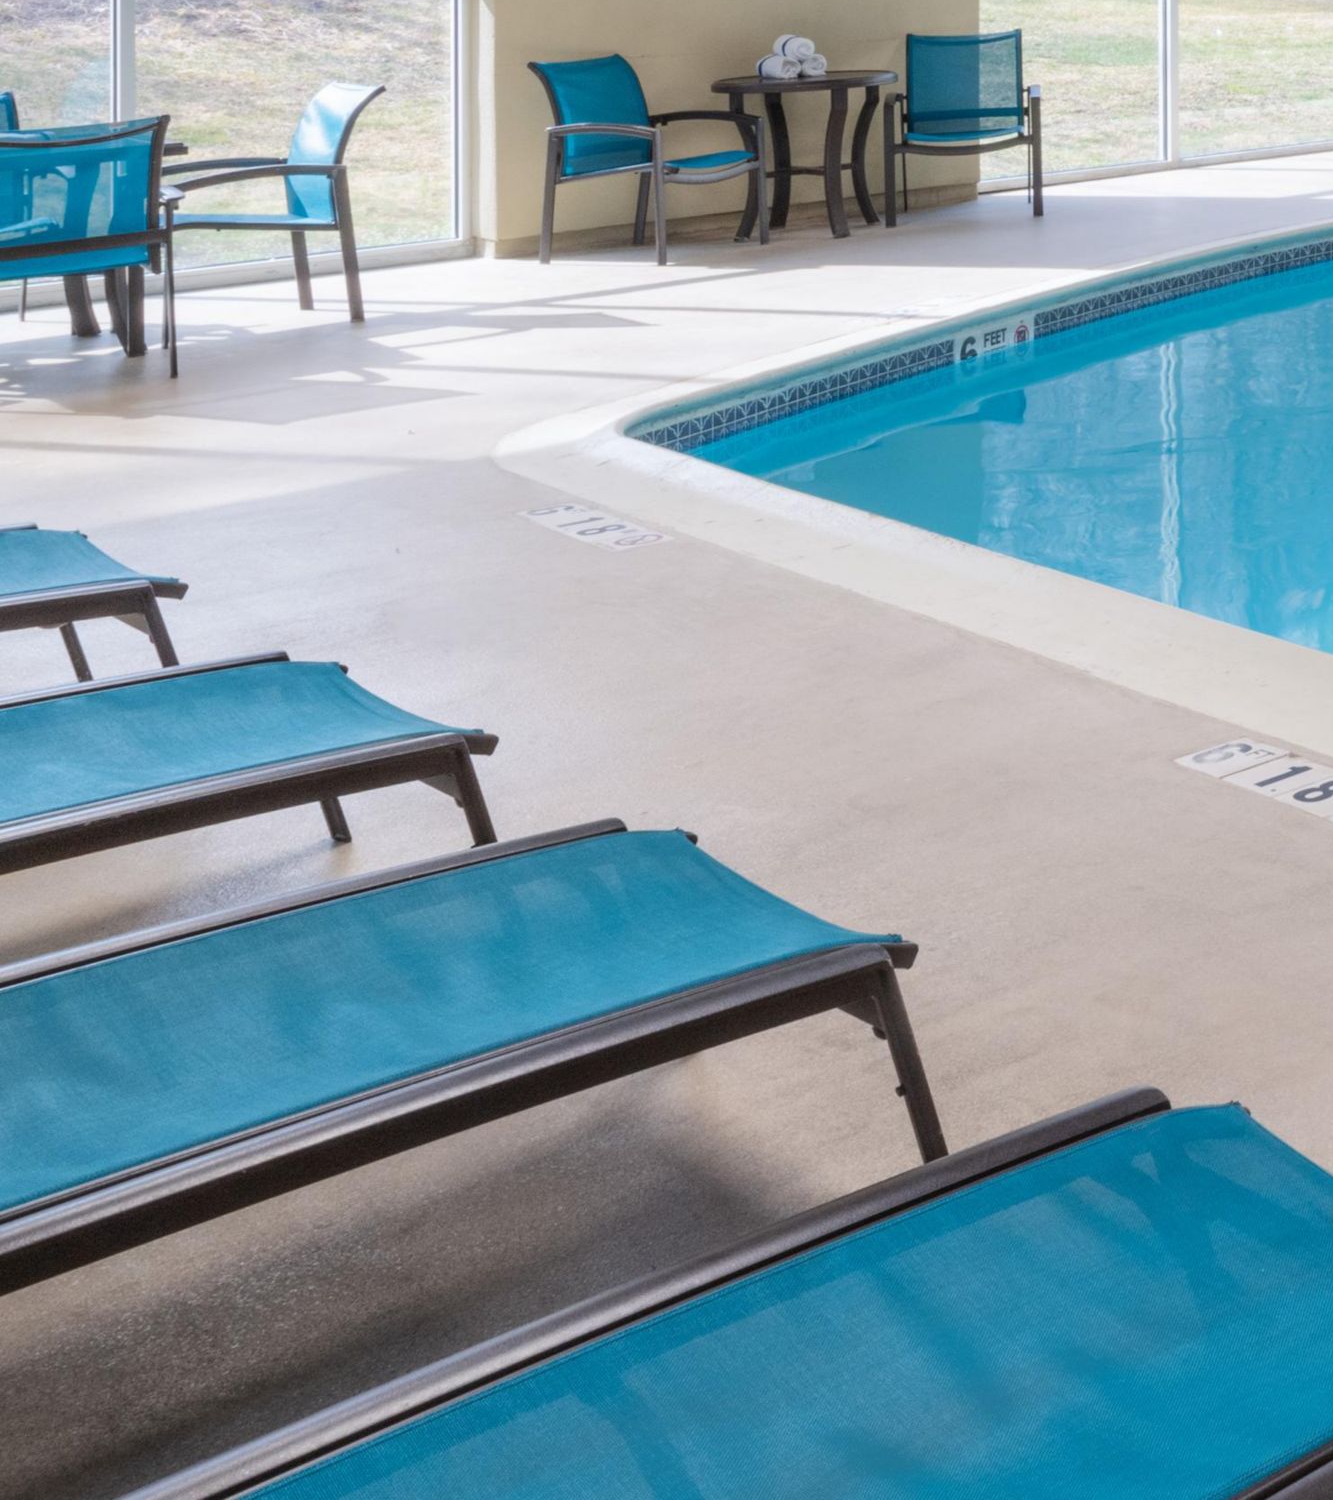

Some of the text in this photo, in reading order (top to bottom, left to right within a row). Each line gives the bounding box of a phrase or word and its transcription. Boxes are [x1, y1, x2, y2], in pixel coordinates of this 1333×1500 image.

[960, 328, 1007, 361] 6 FEET
[1246, 748, 1275, 760] FT
